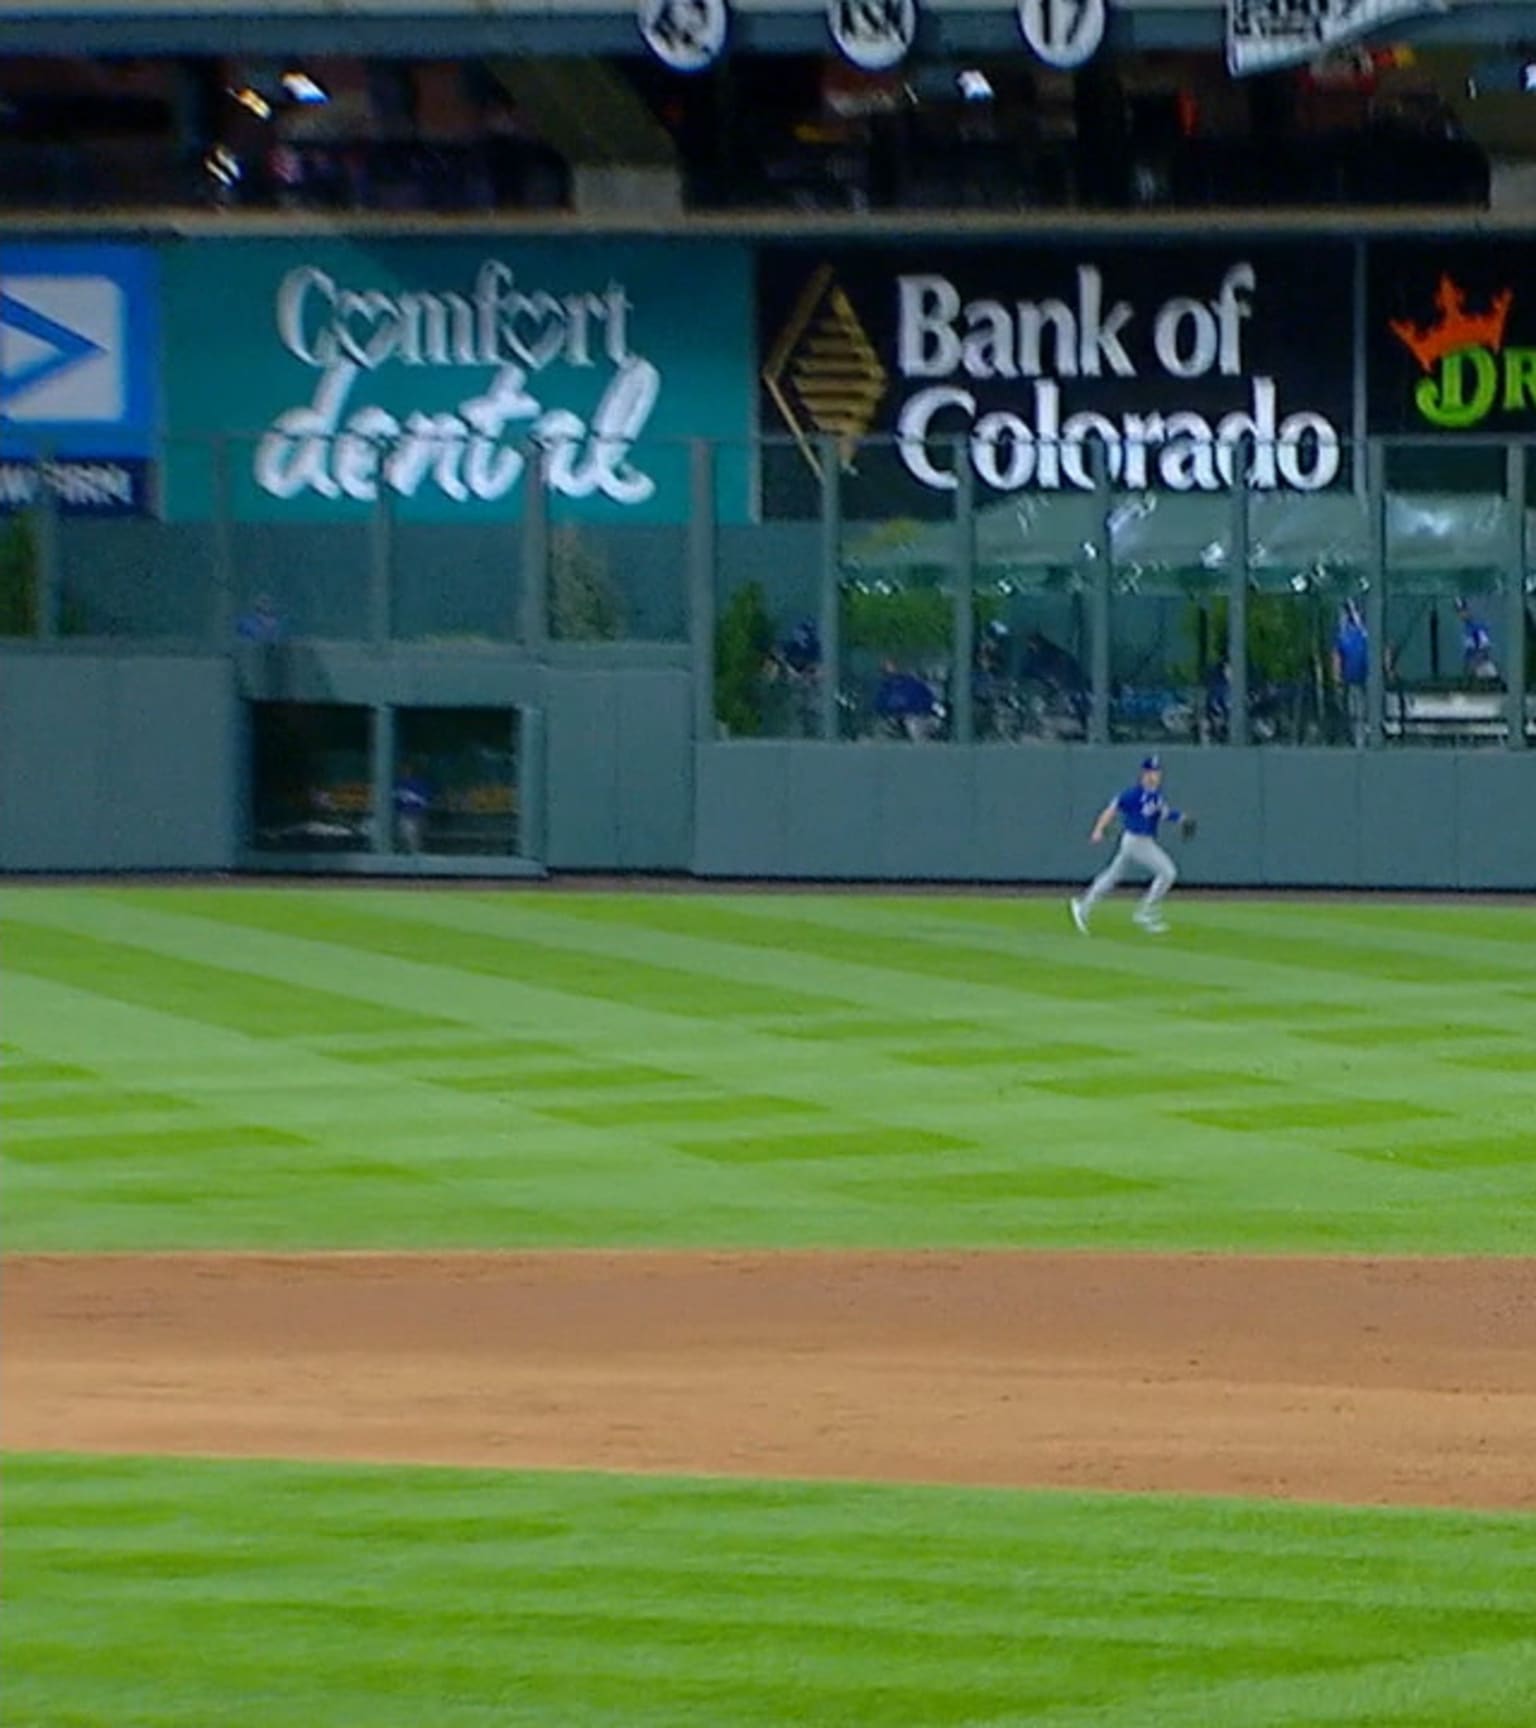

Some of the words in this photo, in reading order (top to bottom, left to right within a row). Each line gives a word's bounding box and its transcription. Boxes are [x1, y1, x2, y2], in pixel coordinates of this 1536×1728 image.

[278, 260, 634, 369] Comfort
[898, 264, 1136, 379] Bank
[1153, 263, 1256, 377] of
[254, 354, 660, 504] dental
[899, 377, 1341, 492] Colorado
